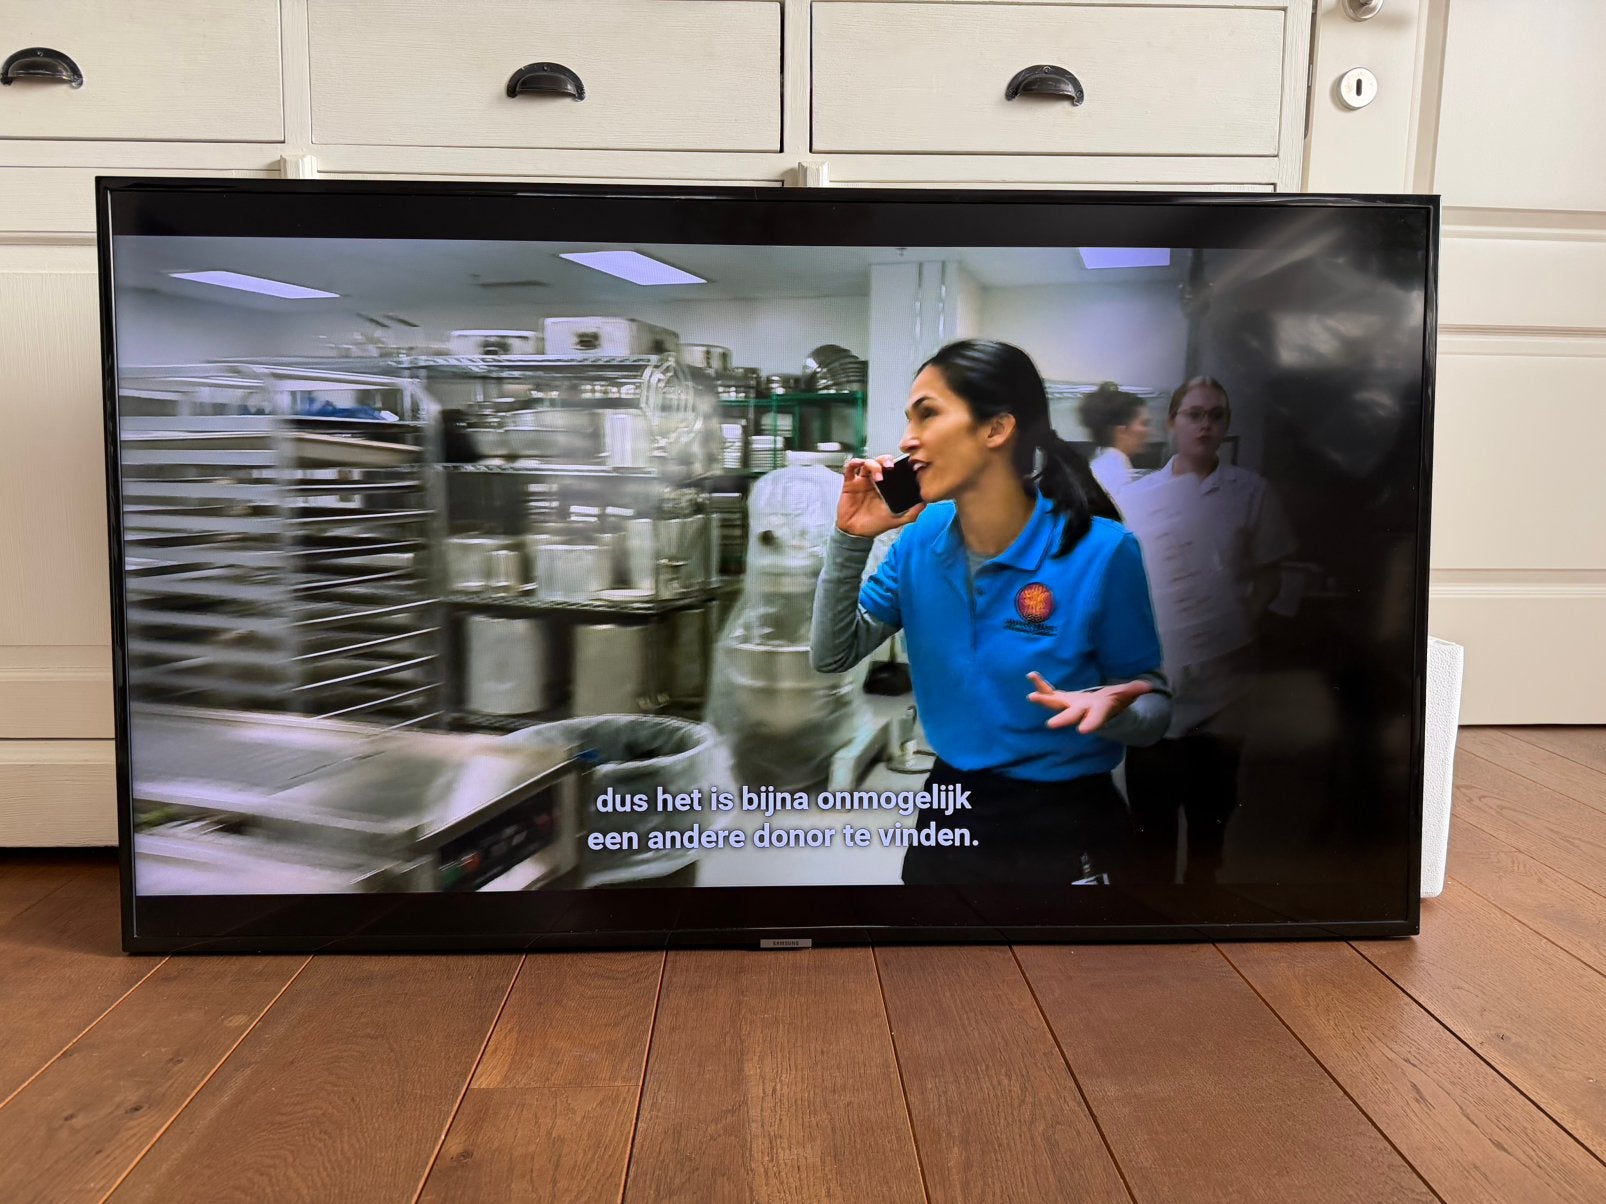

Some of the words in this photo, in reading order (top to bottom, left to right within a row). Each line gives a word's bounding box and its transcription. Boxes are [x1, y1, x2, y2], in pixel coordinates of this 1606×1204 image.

[596, 787, 648, 813] dus
[657, 786, 701, 812] het
[710, 786, 734, 811] is
[742, 785, 809, 817] bijna
[817, 784, 972, 815] onmogelijk
[587, 831, 638, 850] een
[648, 824, 745, 850] andere
[753, 823, 836, 849] donor
[842, 824, 871, 848] te
[878, 821, 980, 847] vinden.
